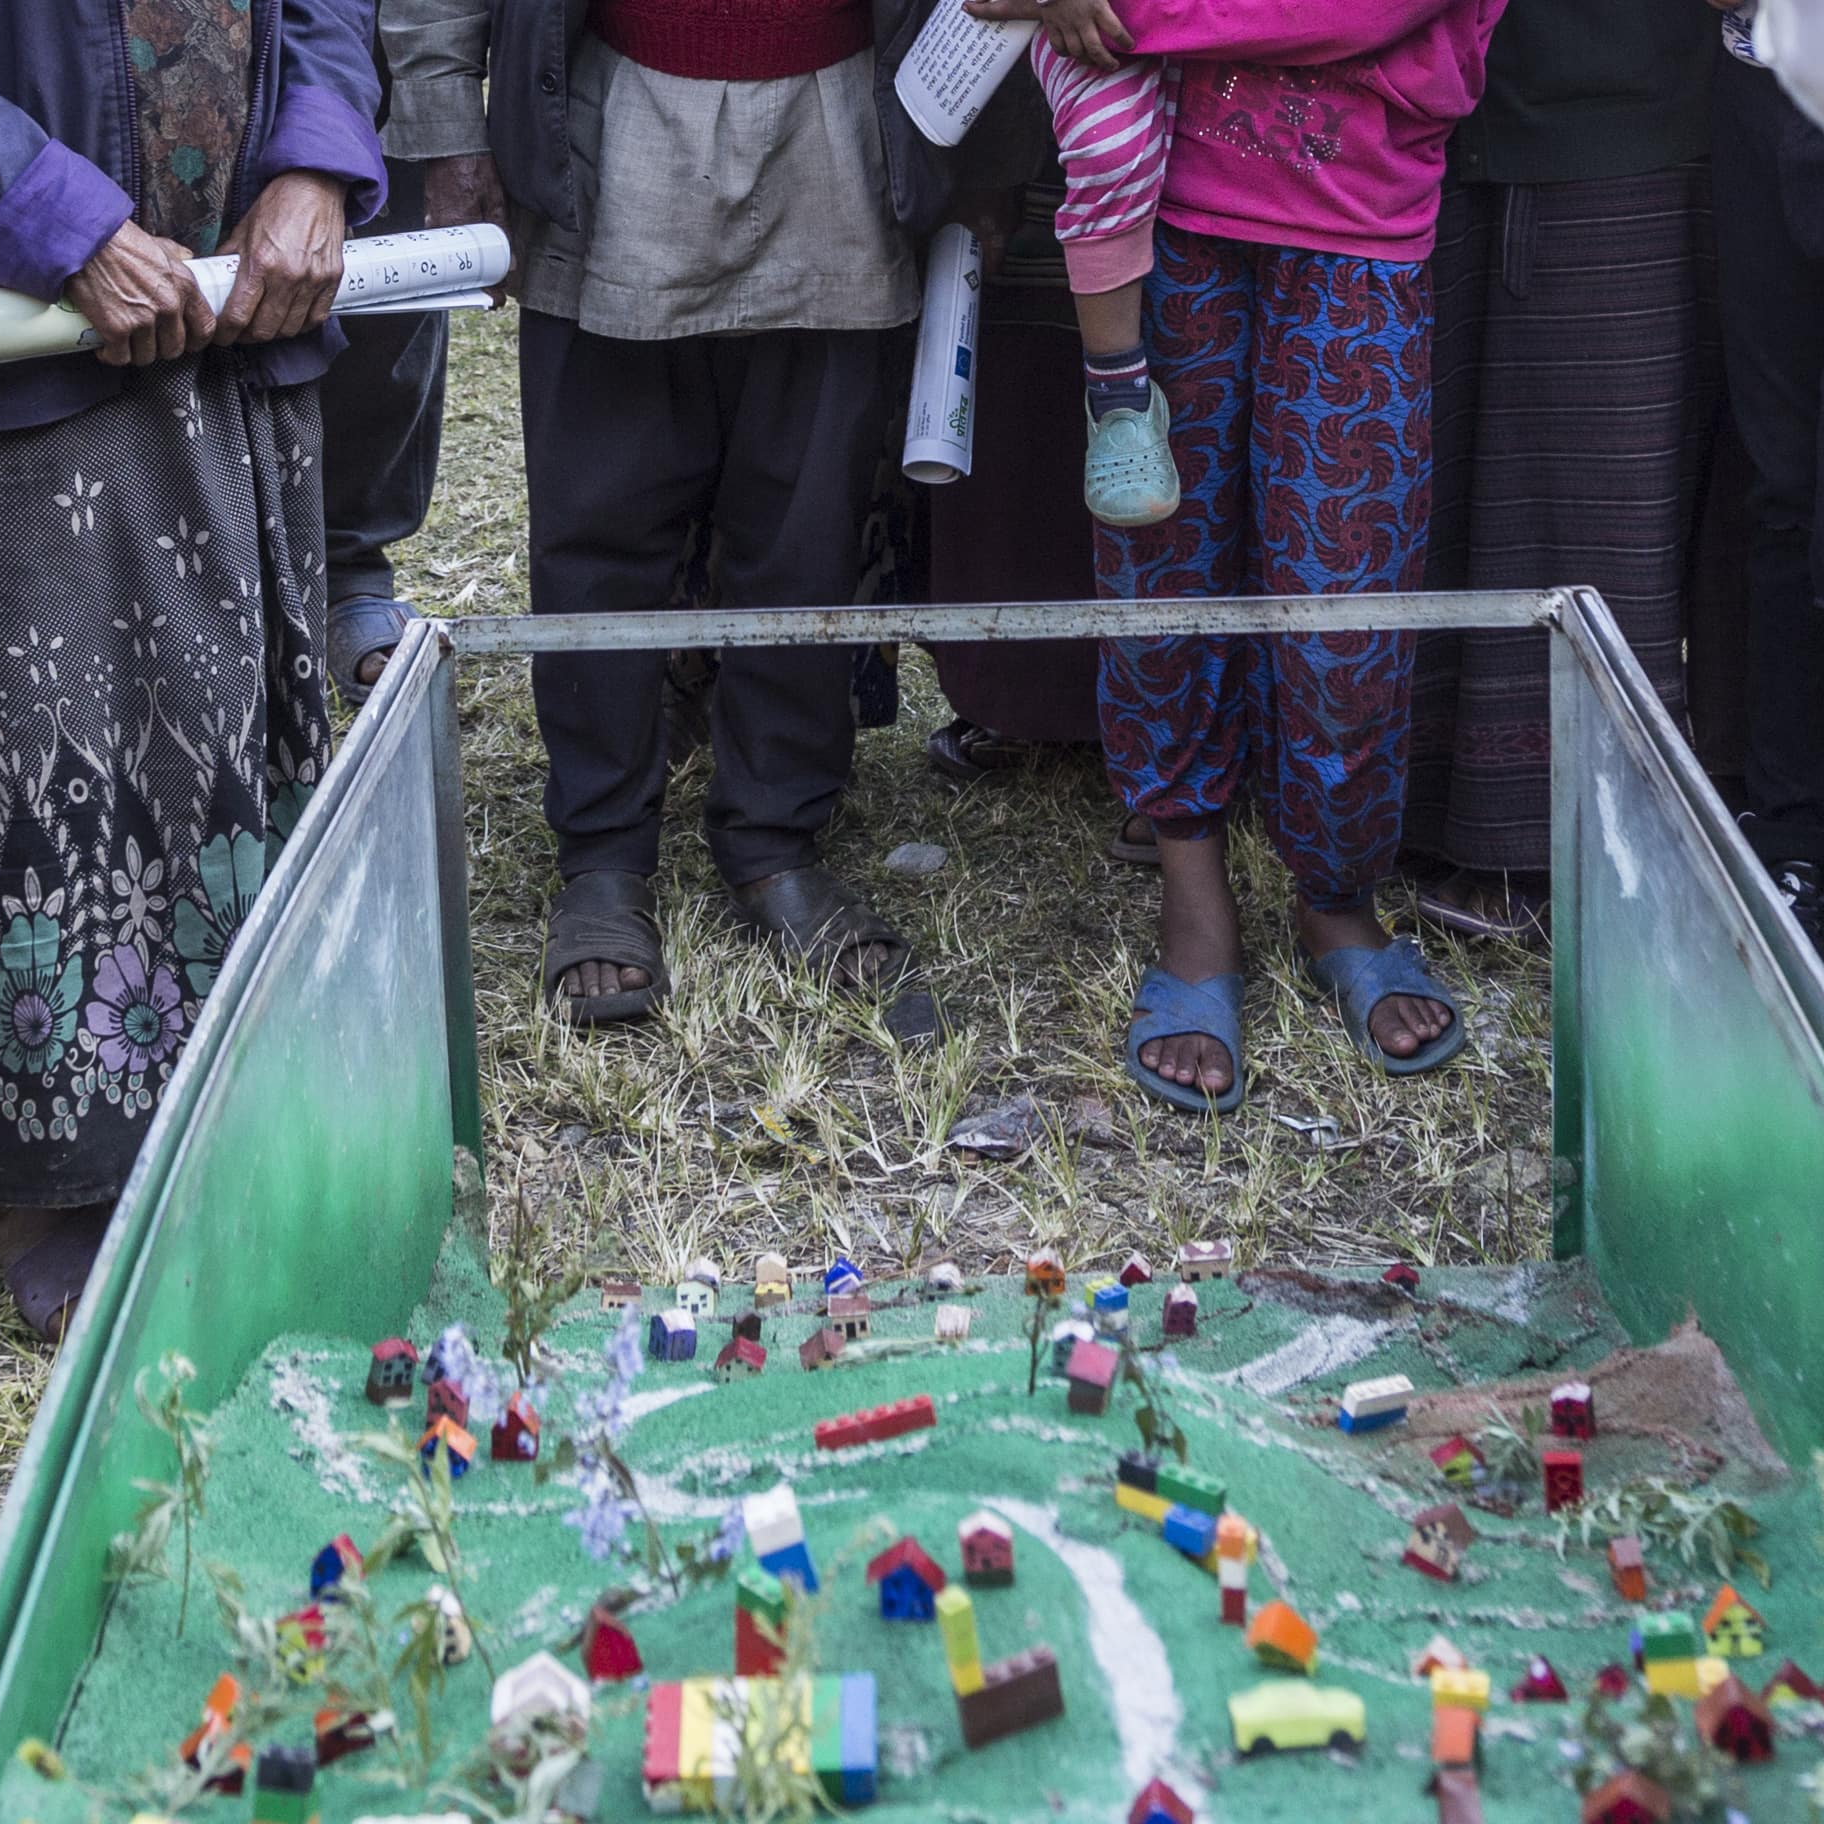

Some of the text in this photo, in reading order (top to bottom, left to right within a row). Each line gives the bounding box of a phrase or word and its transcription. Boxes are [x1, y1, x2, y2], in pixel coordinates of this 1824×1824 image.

[347, 252, 473, 291] १९ २० २१ २२
